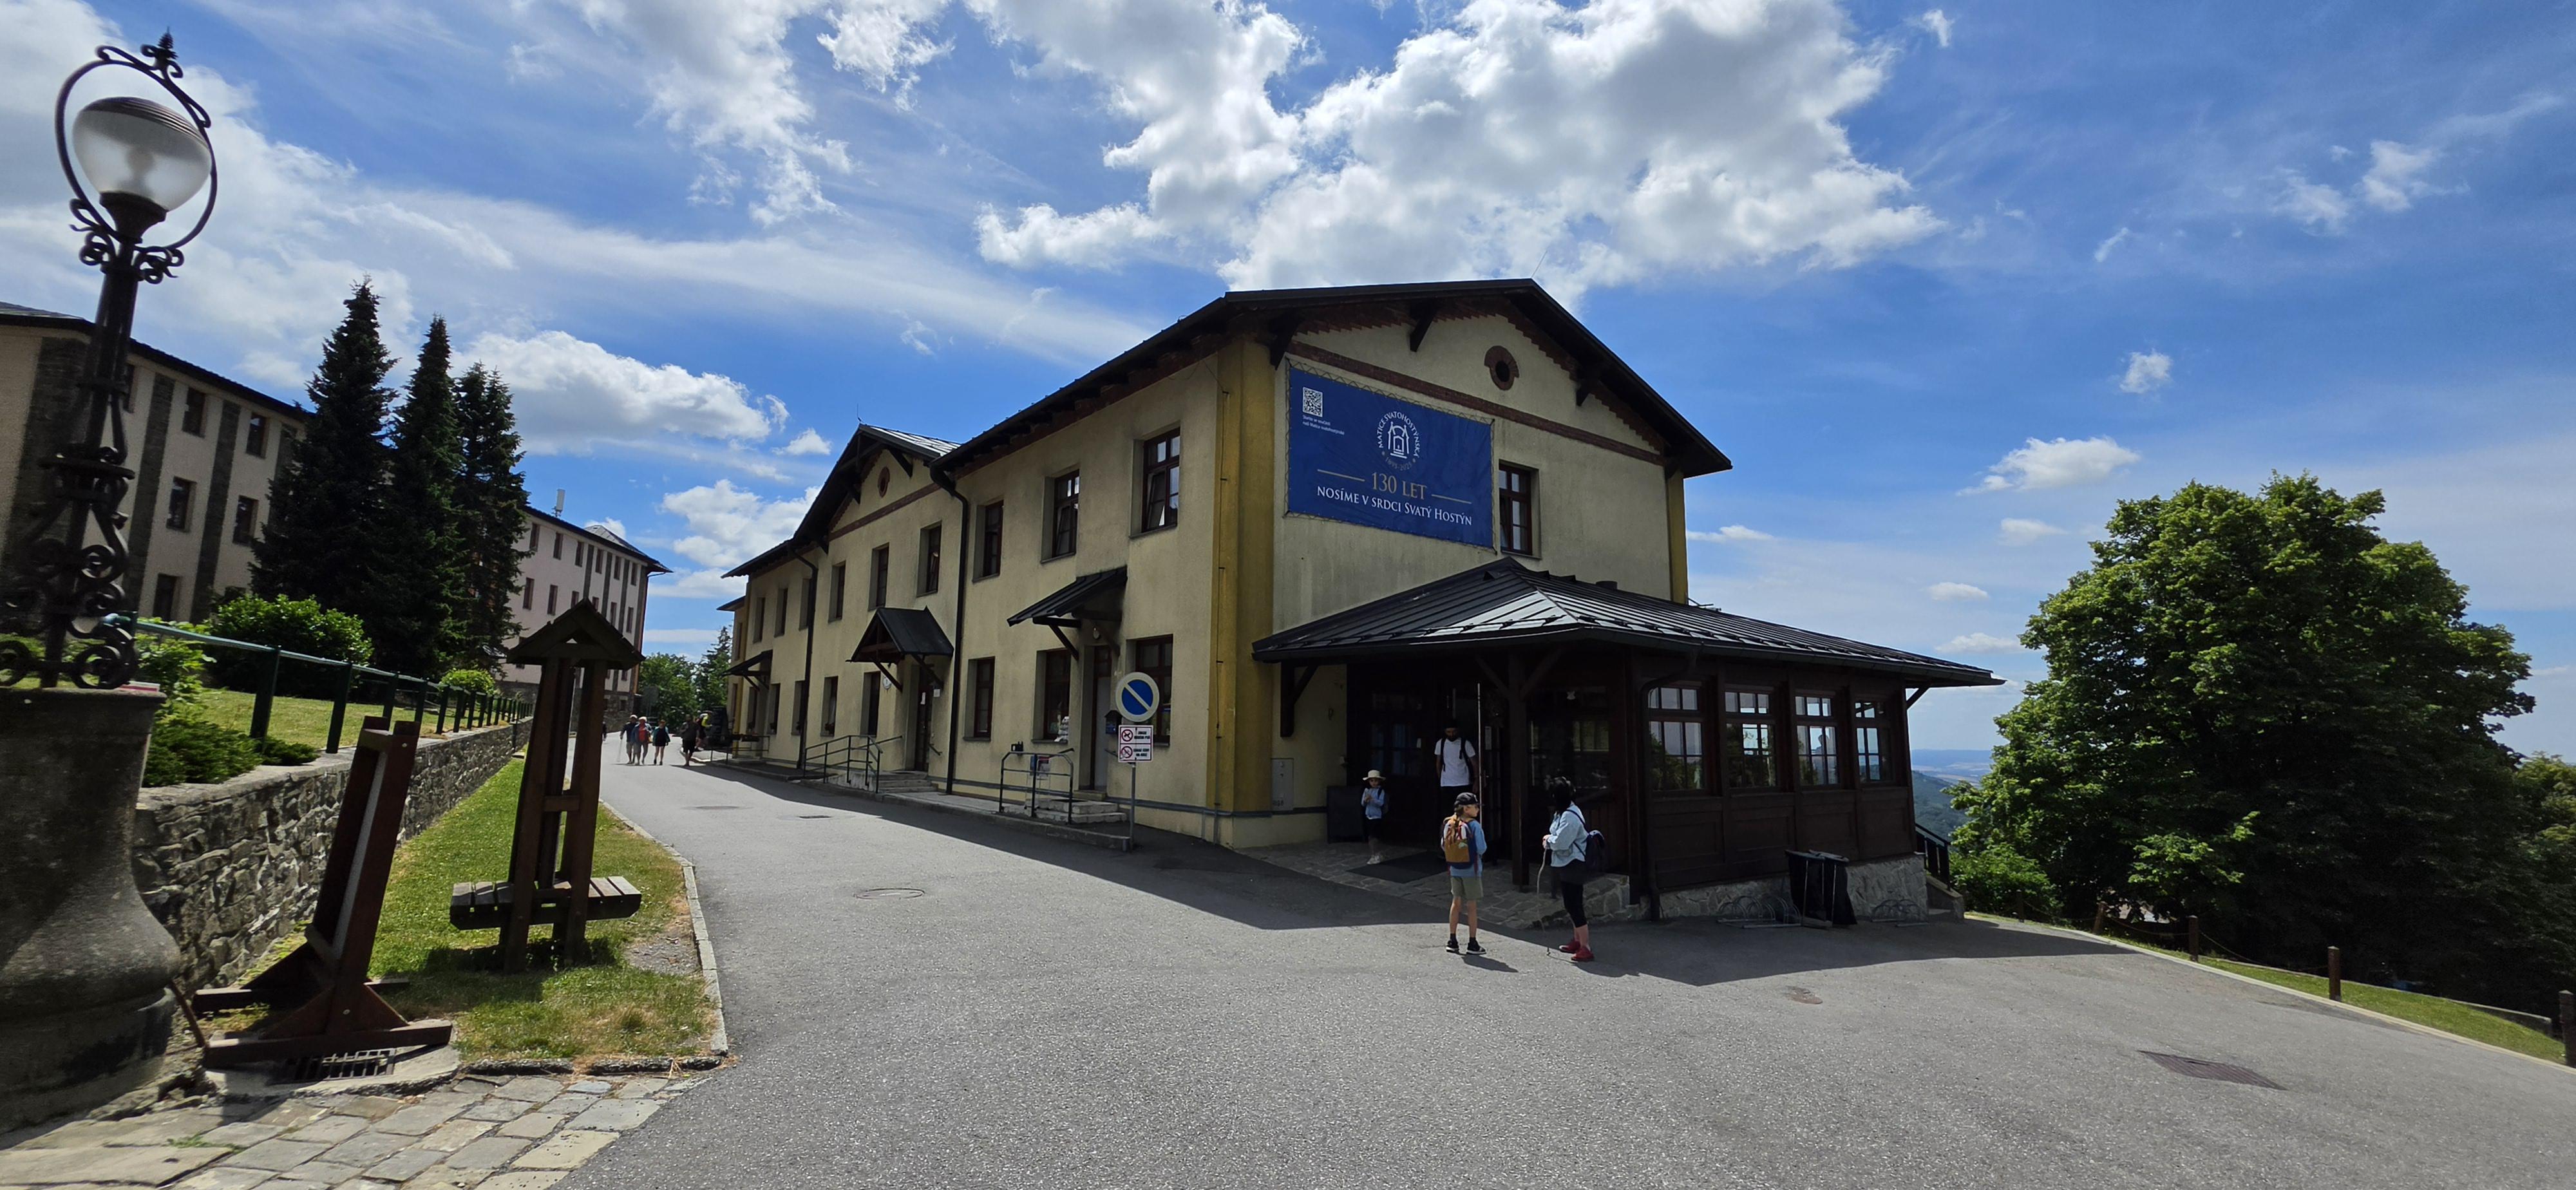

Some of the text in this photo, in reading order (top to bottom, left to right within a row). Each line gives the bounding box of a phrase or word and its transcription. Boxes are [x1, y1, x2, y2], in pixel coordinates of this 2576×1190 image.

[1377, 418, 1386, 448] MATICE
[1317, 486, 1359, 504] NOSÍME
[1361, 495, 1369, 505] V
[1371, 497, 1401, 513] SRDCI
[1372, 472, 1428, 500] 130 LET
